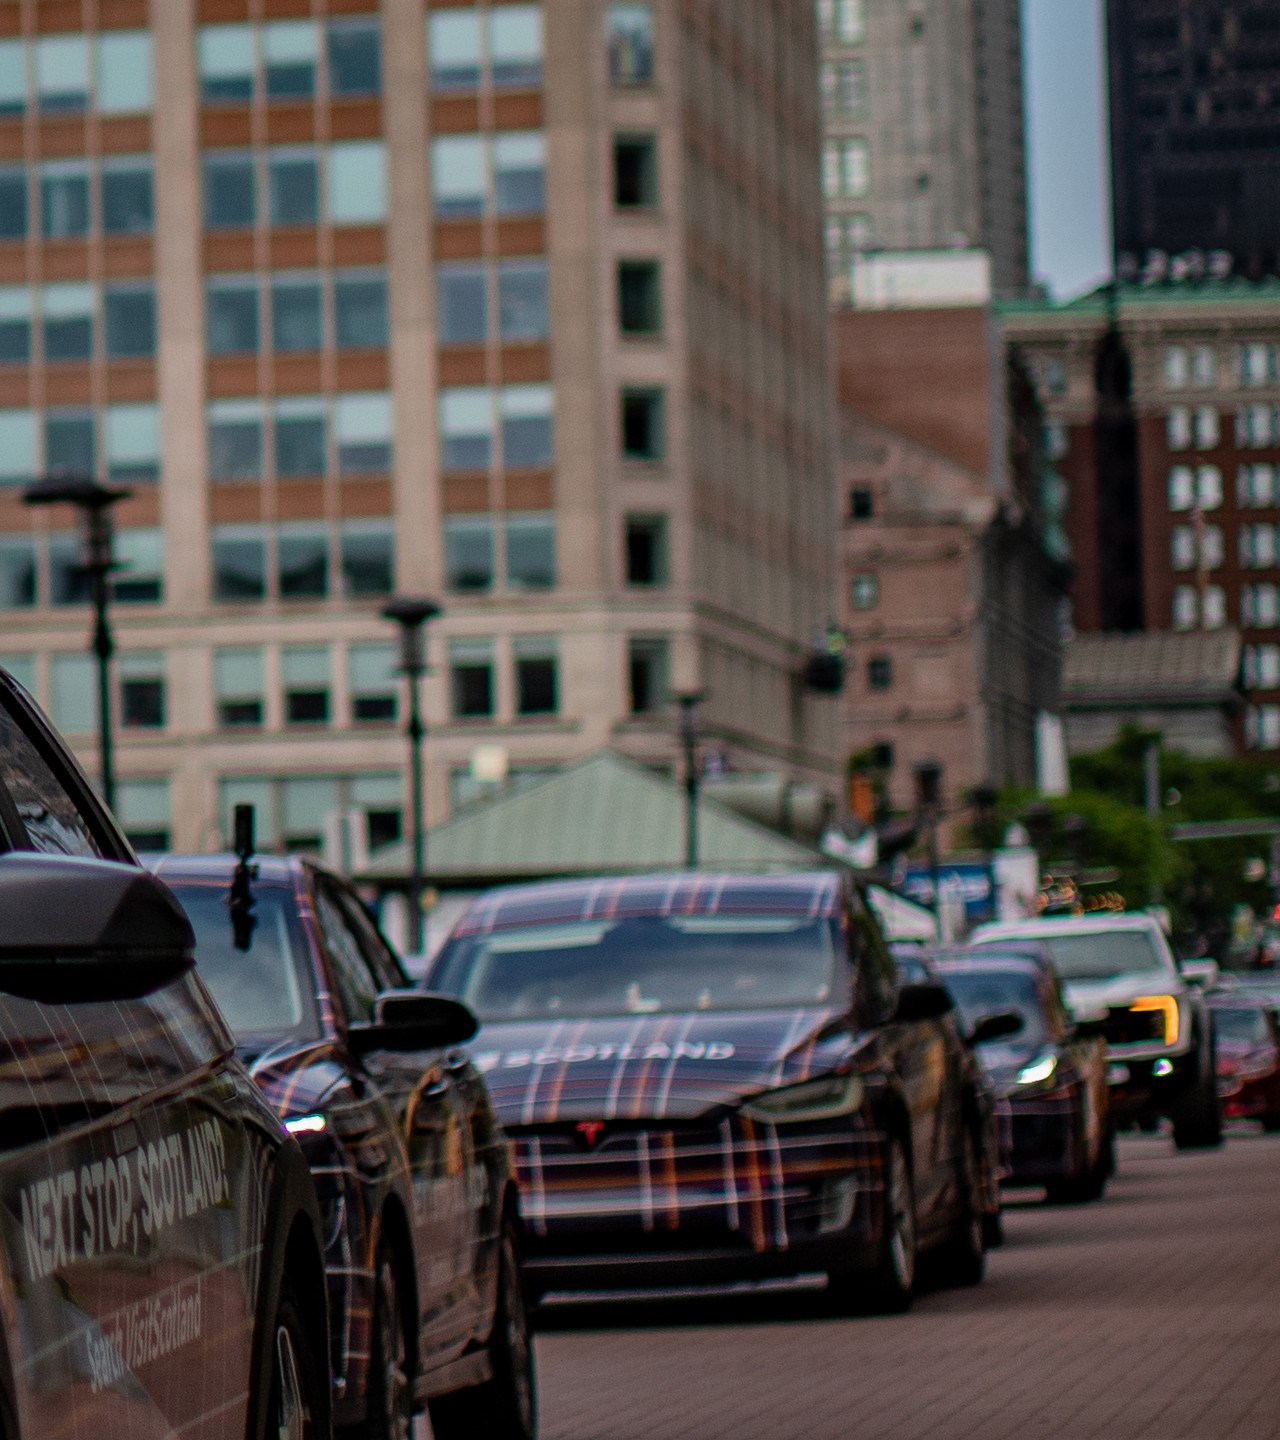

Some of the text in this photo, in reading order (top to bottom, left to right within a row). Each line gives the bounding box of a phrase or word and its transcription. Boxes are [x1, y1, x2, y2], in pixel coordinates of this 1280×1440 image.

[502, 1041, 735, 1069] SCOTLAND
[21, 1170, 77, 1281] NEXT
[80, 1154, 138, 1257] STOP,
[86, 1276, 200, 1394] Search VisitScotland
